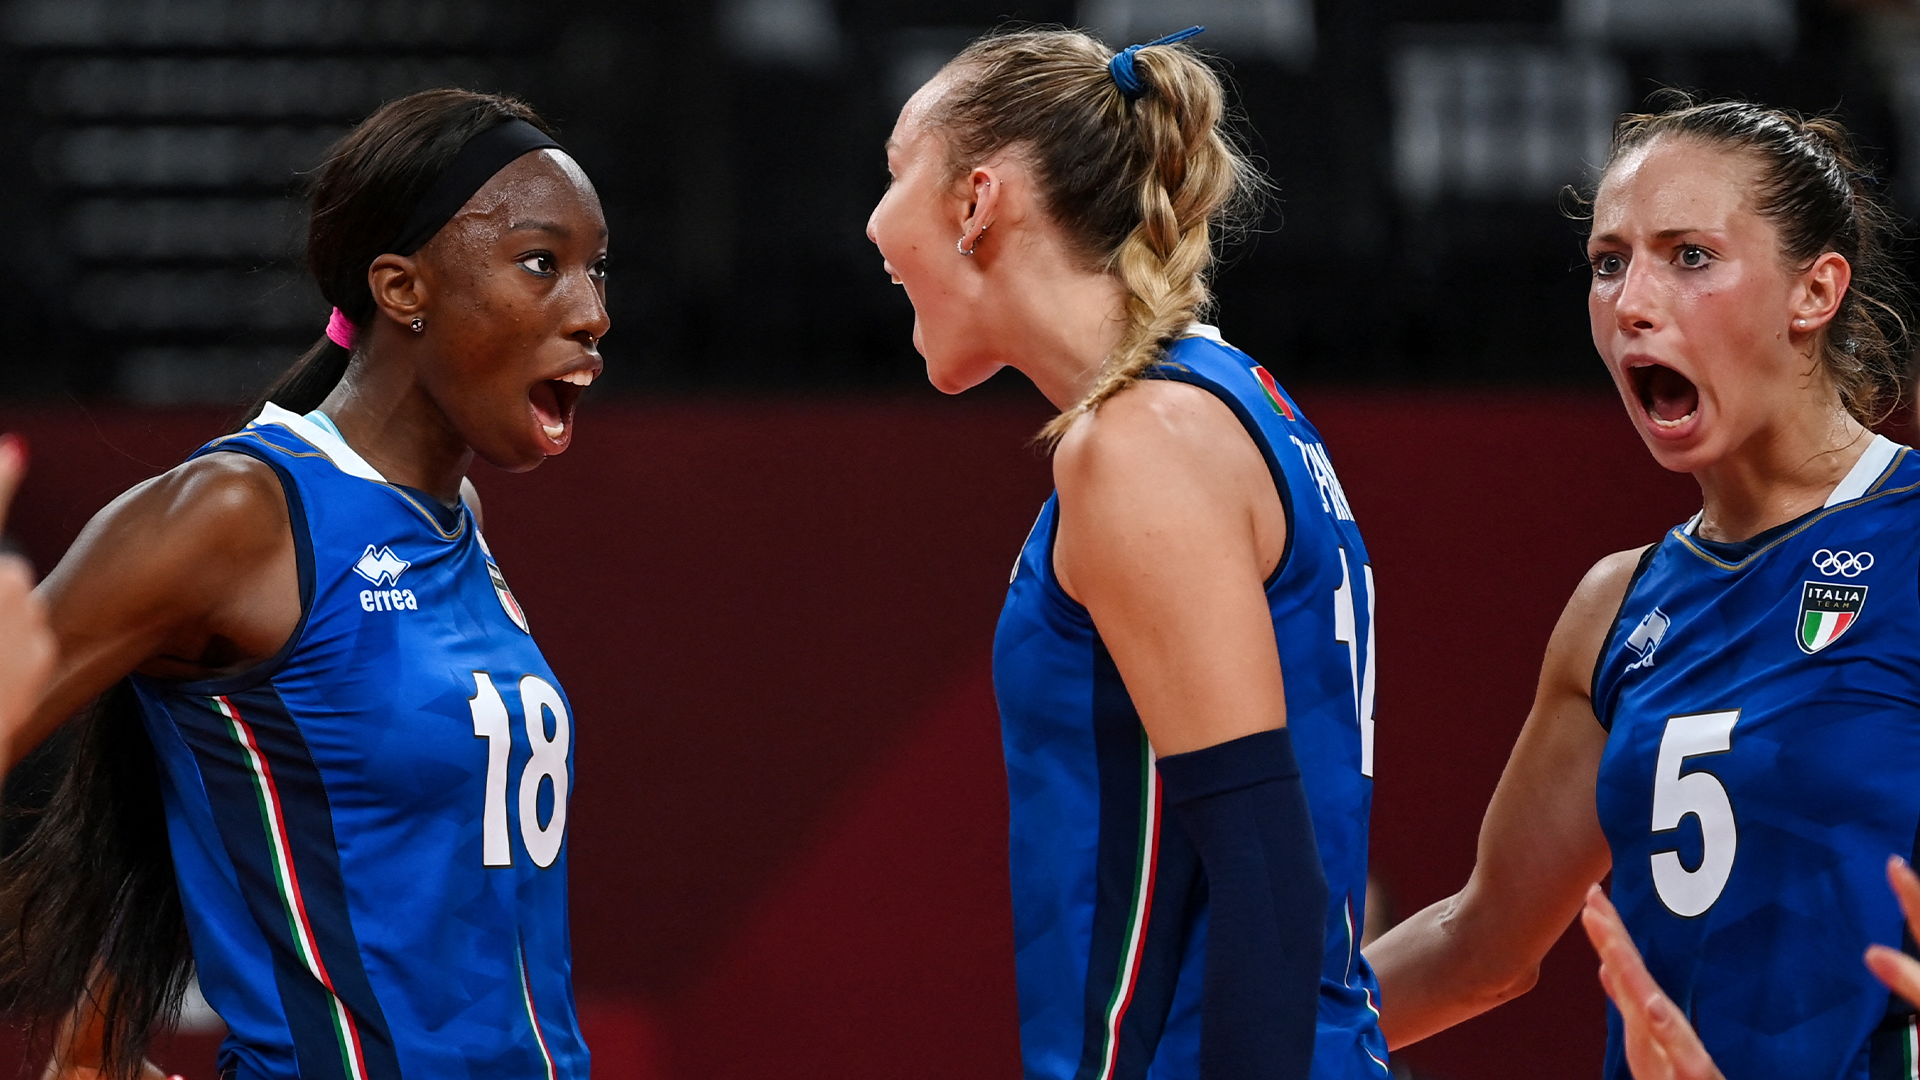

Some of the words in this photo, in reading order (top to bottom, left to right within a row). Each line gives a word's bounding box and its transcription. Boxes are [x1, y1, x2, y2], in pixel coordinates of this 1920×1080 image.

[1808, 587, 1860, 602] ITALIA
[1816, 600, 1850, 609] TEAM
[468, 670, 571, 870] 18
[1650, 708, 1742, 918] 5
